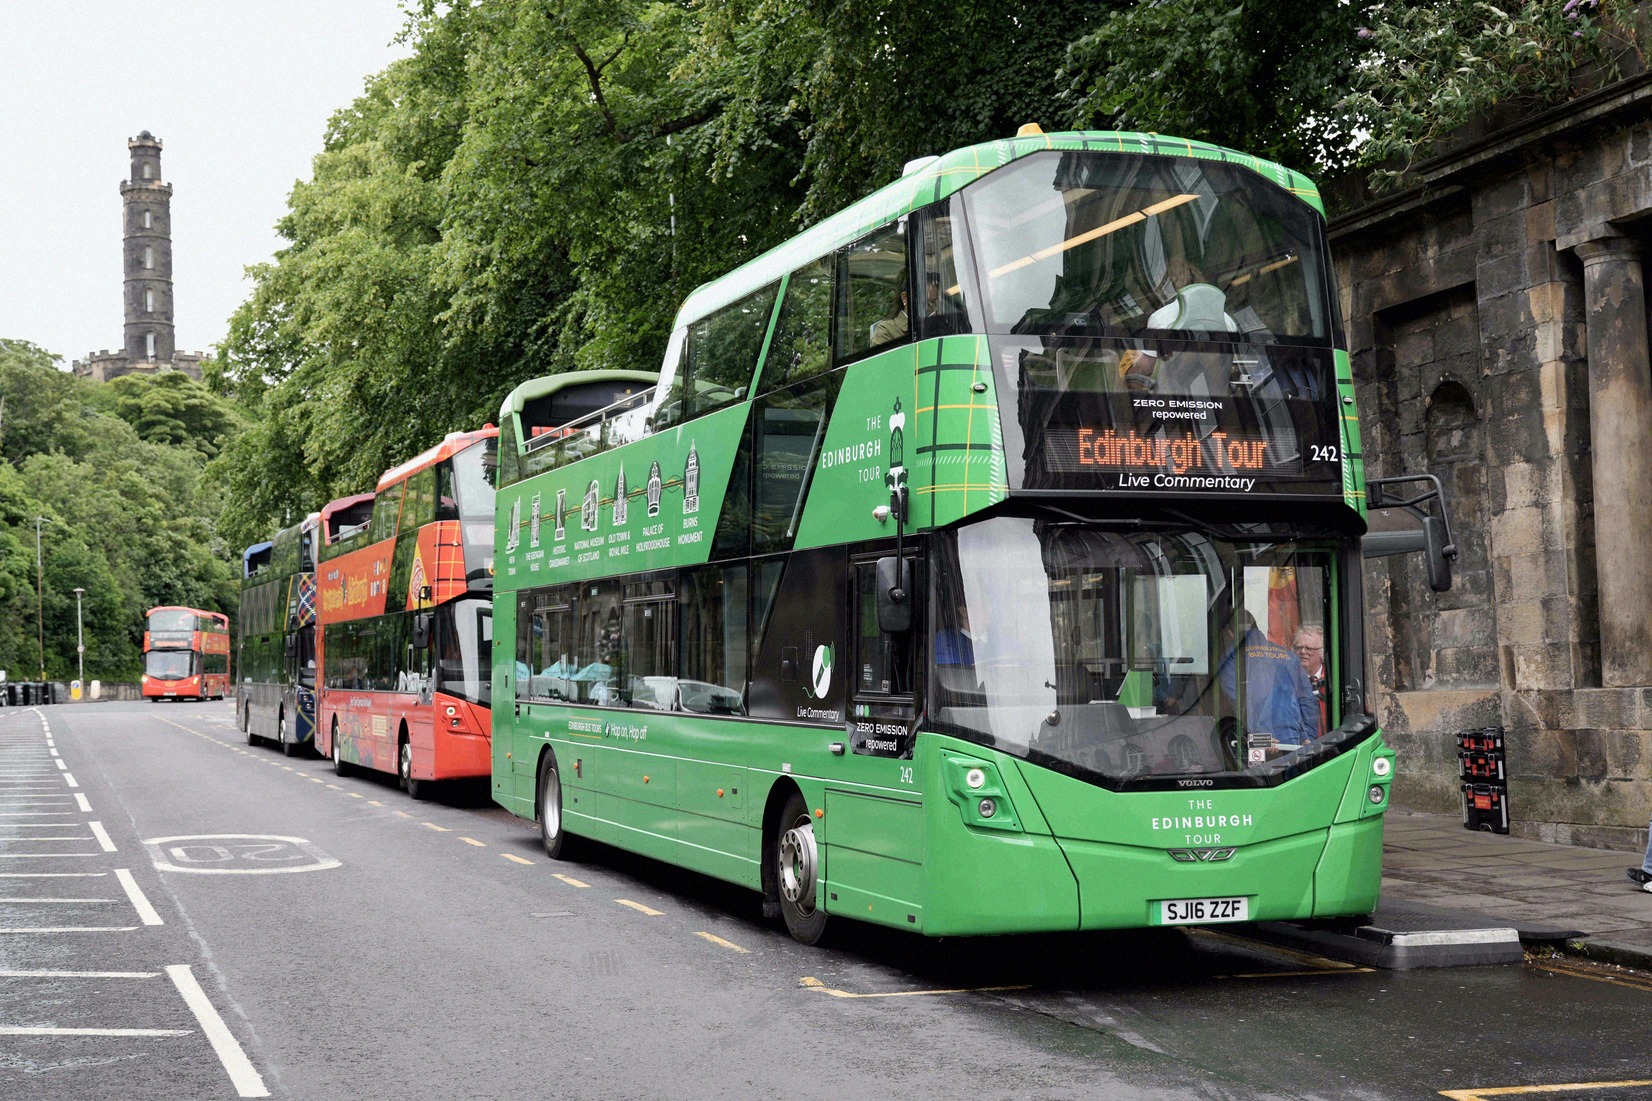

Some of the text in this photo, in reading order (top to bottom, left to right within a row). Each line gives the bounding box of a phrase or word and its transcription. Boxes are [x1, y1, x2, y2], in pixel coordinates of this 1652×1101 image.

[1133, 399, 1223, 410] ZERO EMISSION
[1152, 410, 1207, 420] repowered
[866, 415, 882, 431] THE
[822, 438, 881, 469] EDINBURGH
[1078, 428, 1267, 474] Edinburgh Tour
[1310, 444, 1338, 462] 242
[771, 463, 807, 471] EMISSIO
[858, 465, 881, 483] TOUR
[1118, 472, 1255, 492] Live Commentary
[683, 516, 698, 529] BURNS
[608, 533, 616, 543] OLD
[616, 531, 627, 542] TOWN
[642, 523, 664, 537] PALACE OF
[635, 537, 671, 552] HOLYROODHOUSE
[677, 531, 703, 545] MONUMENT
[608, 544, 630, 557] ROYAL MILE
[797, 705, 840, 722] Live Commentary
[611, 722, 648, 743] Hop on, Hop off
[856, 722, 908, 736] ZERO EMISSION
[865, 738, 897, 751] repowered
[900, 766, 914, 784] 242
[1177, 779, 1214, 787] VOLVO
[1188, 799, 1213, 810] THE
[1152, 814, 1253, 830] EDINBURGH
[1184, 833, 1221, 845] TOUR
[169, 844, 303, 862] 20
[1167, 900, 1242, 920] SJ16 ZZF
